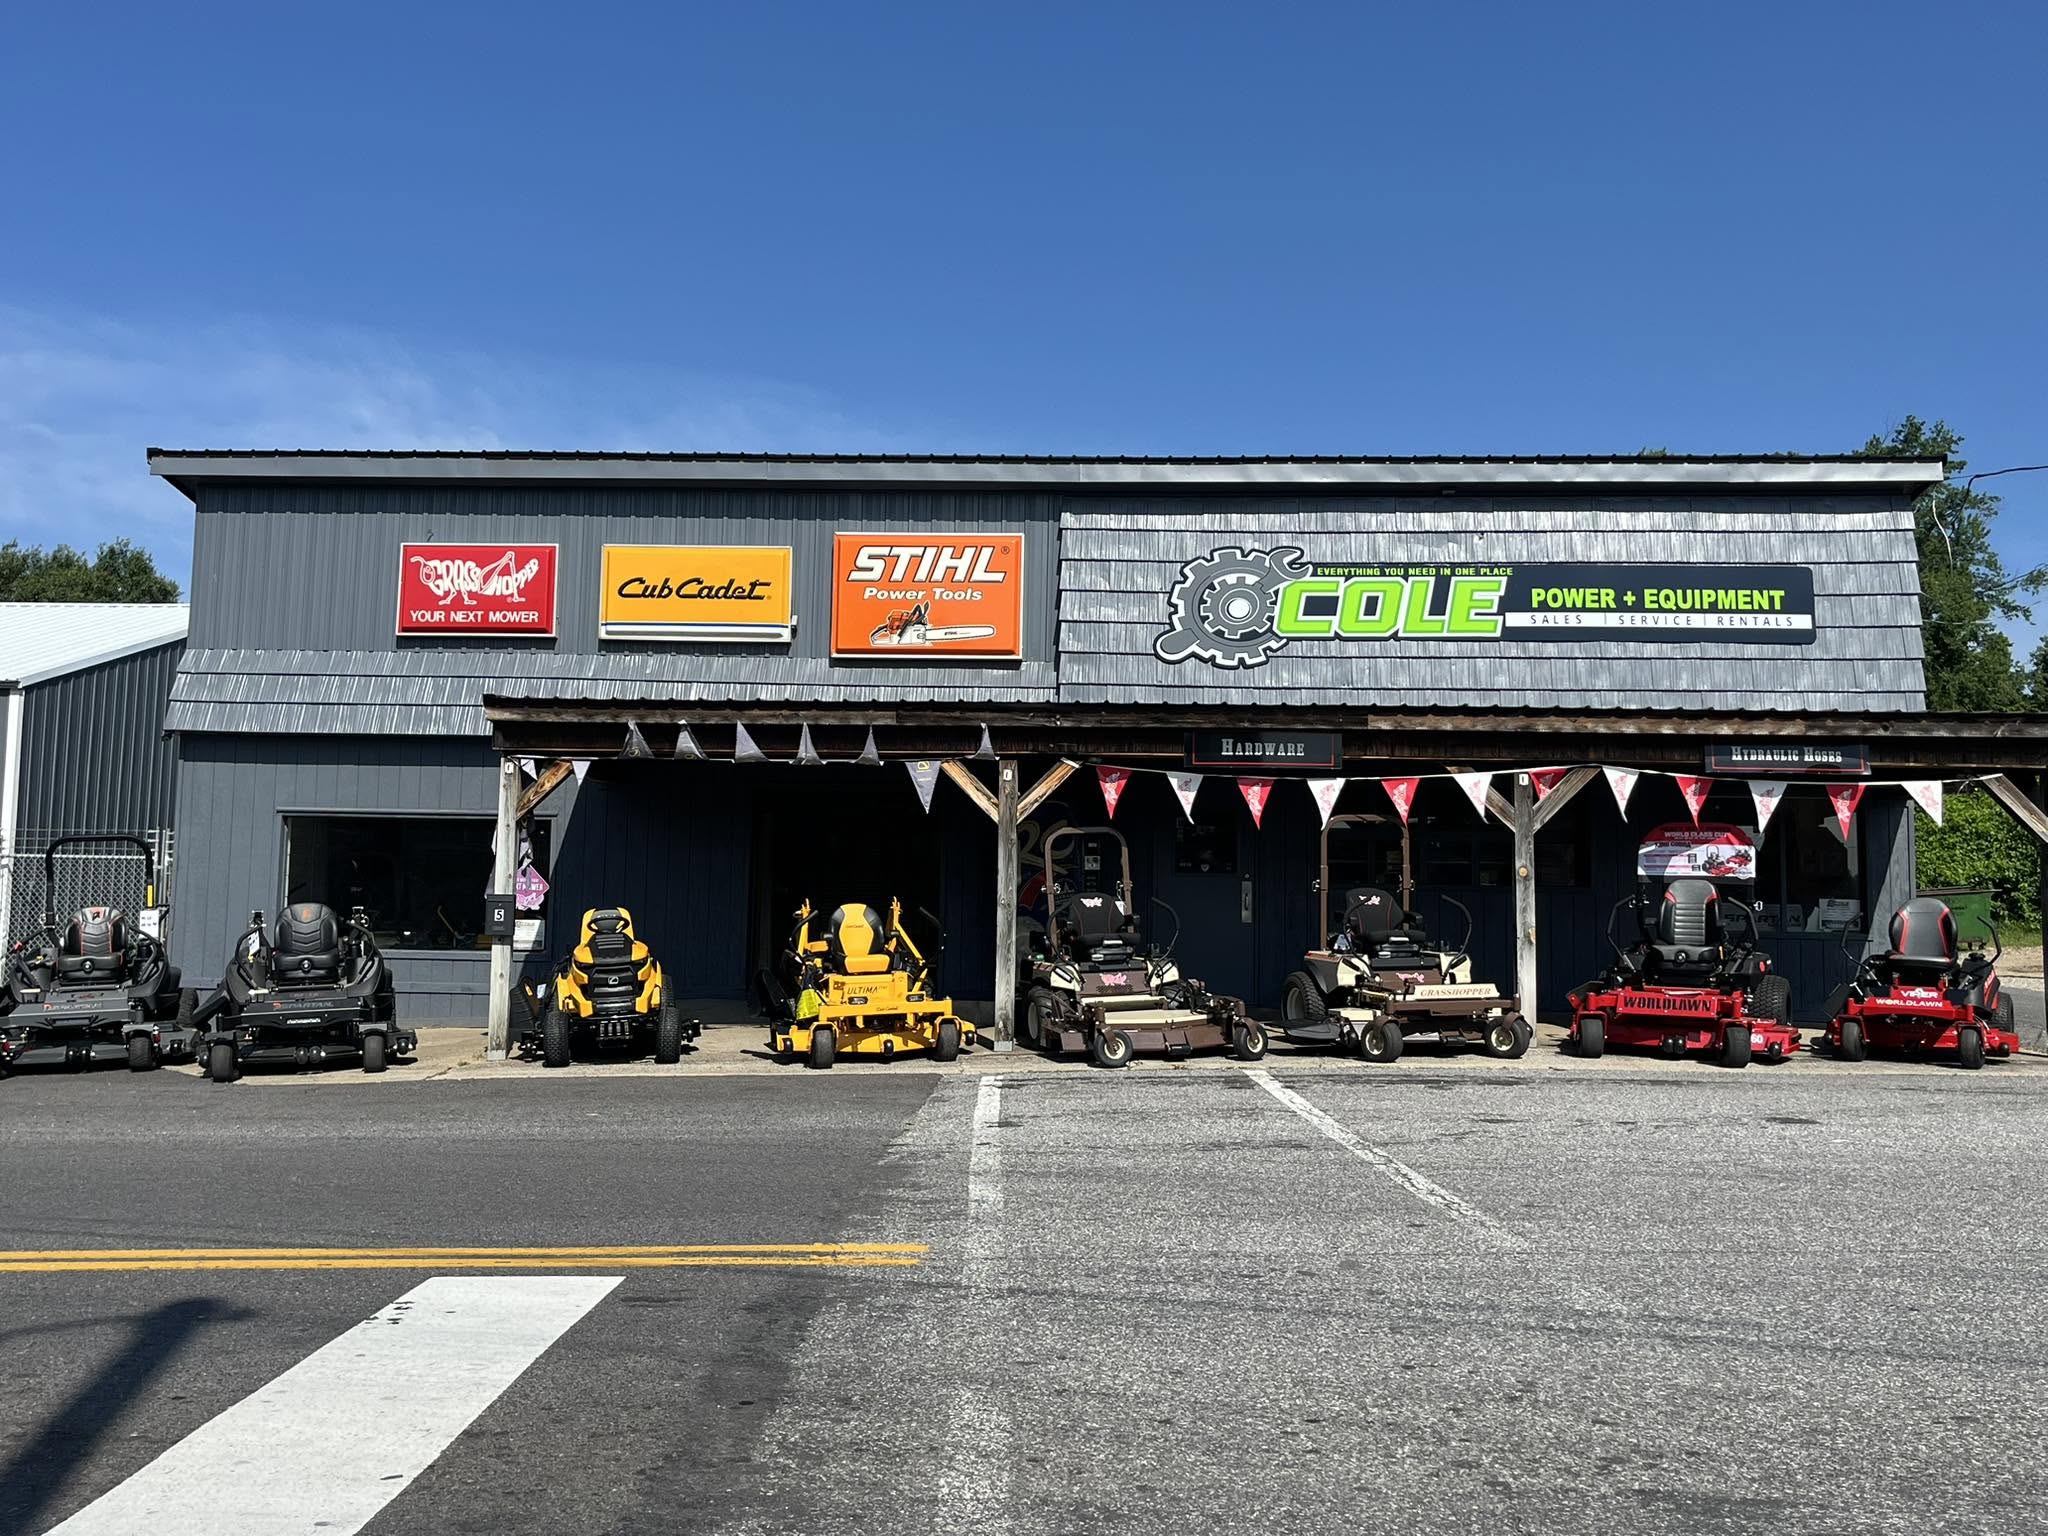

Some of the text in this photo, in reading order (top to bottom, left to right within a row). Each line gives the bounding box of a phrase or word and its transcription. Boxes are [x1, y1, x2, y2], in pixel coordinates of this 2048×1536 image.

[846, 545, 1007, 583] STIHL
[1317, 567, 1514, 576] EVERYTHING YOU NEED IN ONE PLACE
[617, 577, 772, 600] Cub Cadet
[863, 586, 983, 601] Power Tools
[1530, 588, 1785, 610] POWER + EQUIPMENT
[1274, 577, 1506, 637] COLE
[410, 610, 539, 623] YOUR NEXT MOWER
[1530, 614, 1794, 627] SALES SERVICE RENTALS
[495, 910, 503, 920] 5
[1724, 914, 1801, 924] SPRTN
[847, 986, 878, 995] ULTIMA
[1420, 987, 1493, 997] GRASSHOPPER
[1624, 996, 1712, 1012] WORLDLAWN
[1875, 998, 1943, 1008] WORLDLAWN
[1750, 1033, 1764, 1042] 60
